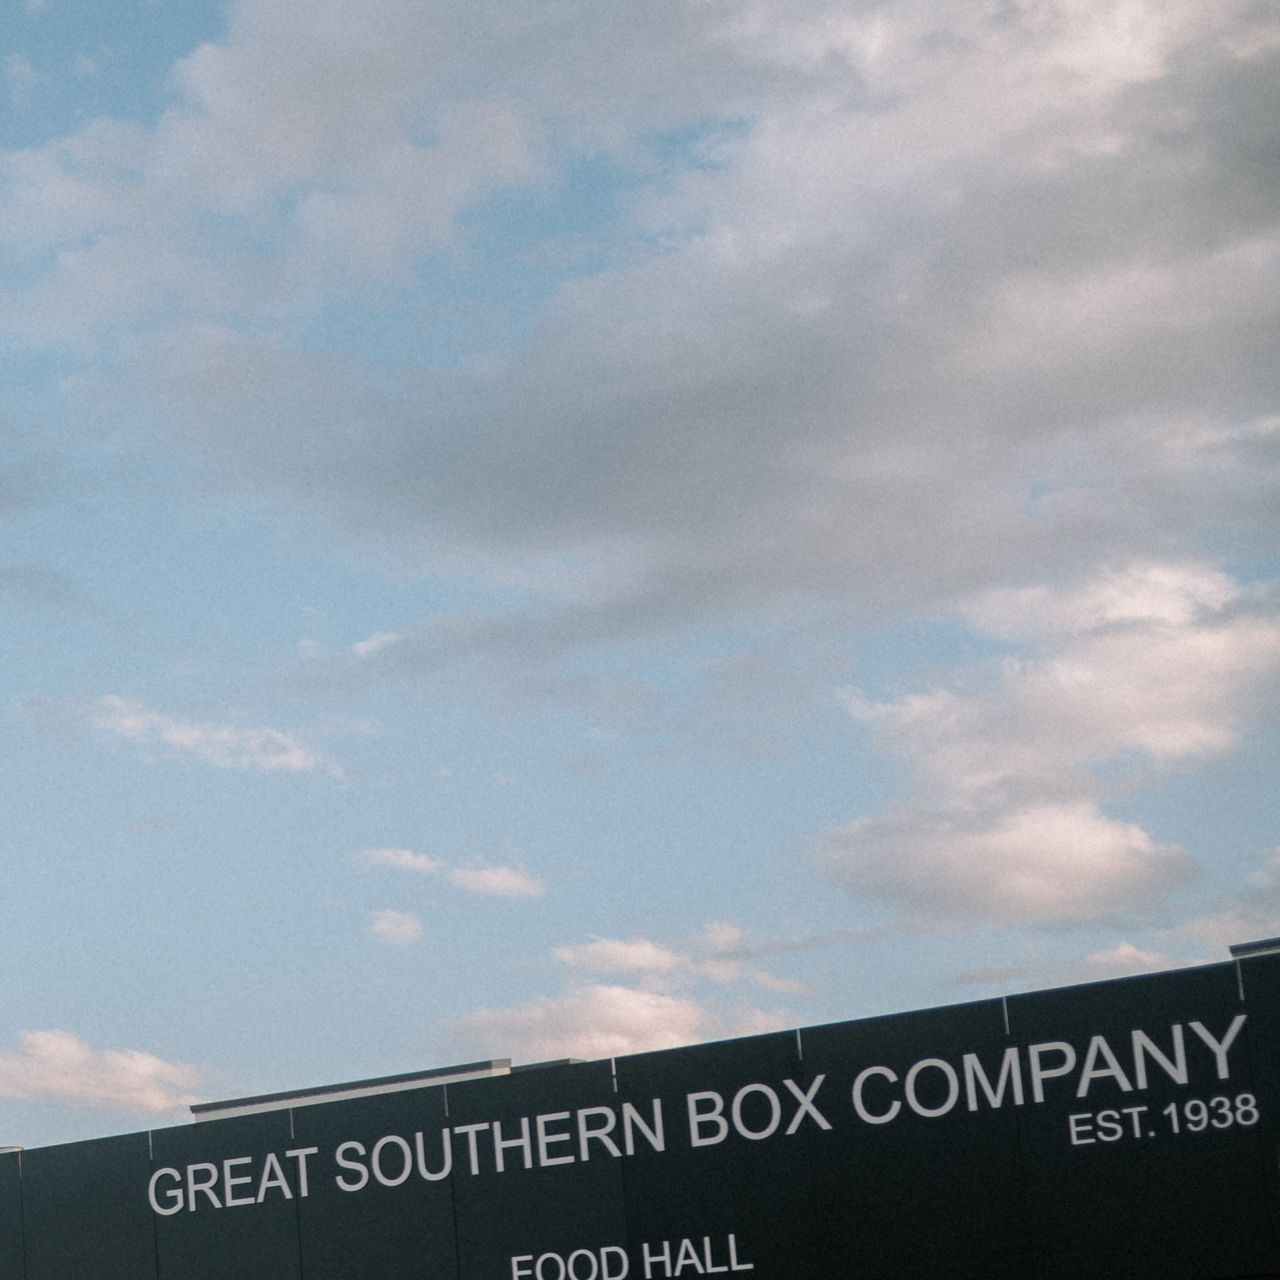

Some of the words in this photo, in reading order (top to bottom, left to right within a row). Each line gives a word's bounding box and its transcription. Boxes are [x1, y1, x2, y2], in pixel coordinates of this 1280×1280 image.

[147, 1146, 319, 1216] GREAT
[335, 1097, 666, 1193] SOUTHERN
[687, 1073, 833, 1148] BOX
[851, 1014, 1248, 1125] COMPANY
[1069, 1105, 1156, 1146] EST.
[1162, 1093, 1260, 1134] 1938
[642, 1233, 755, 1280] HALL
